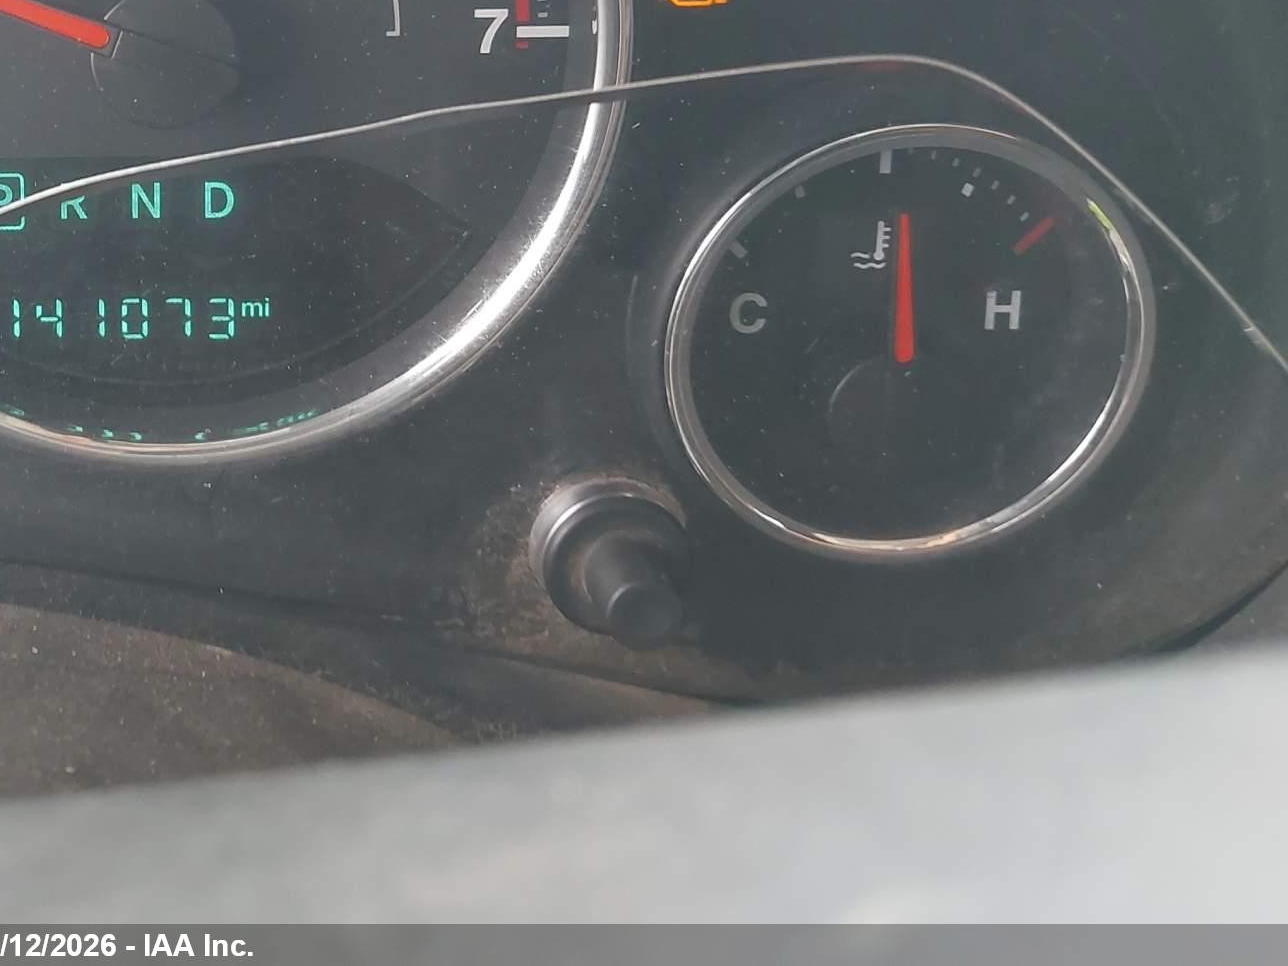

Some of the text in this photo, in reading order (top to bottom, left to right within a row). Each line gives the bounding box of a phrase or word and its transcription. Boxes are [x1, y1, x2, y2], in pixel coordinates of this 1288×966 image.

[474, 8, 508, 55] 7
[131, 182, 161, 219] N
[204, 181, 235, 219] D
[13, 297, 271, 340] 141073 mi
[729, 292, 768, 334] C
[985, 290, 1021, 330] H
